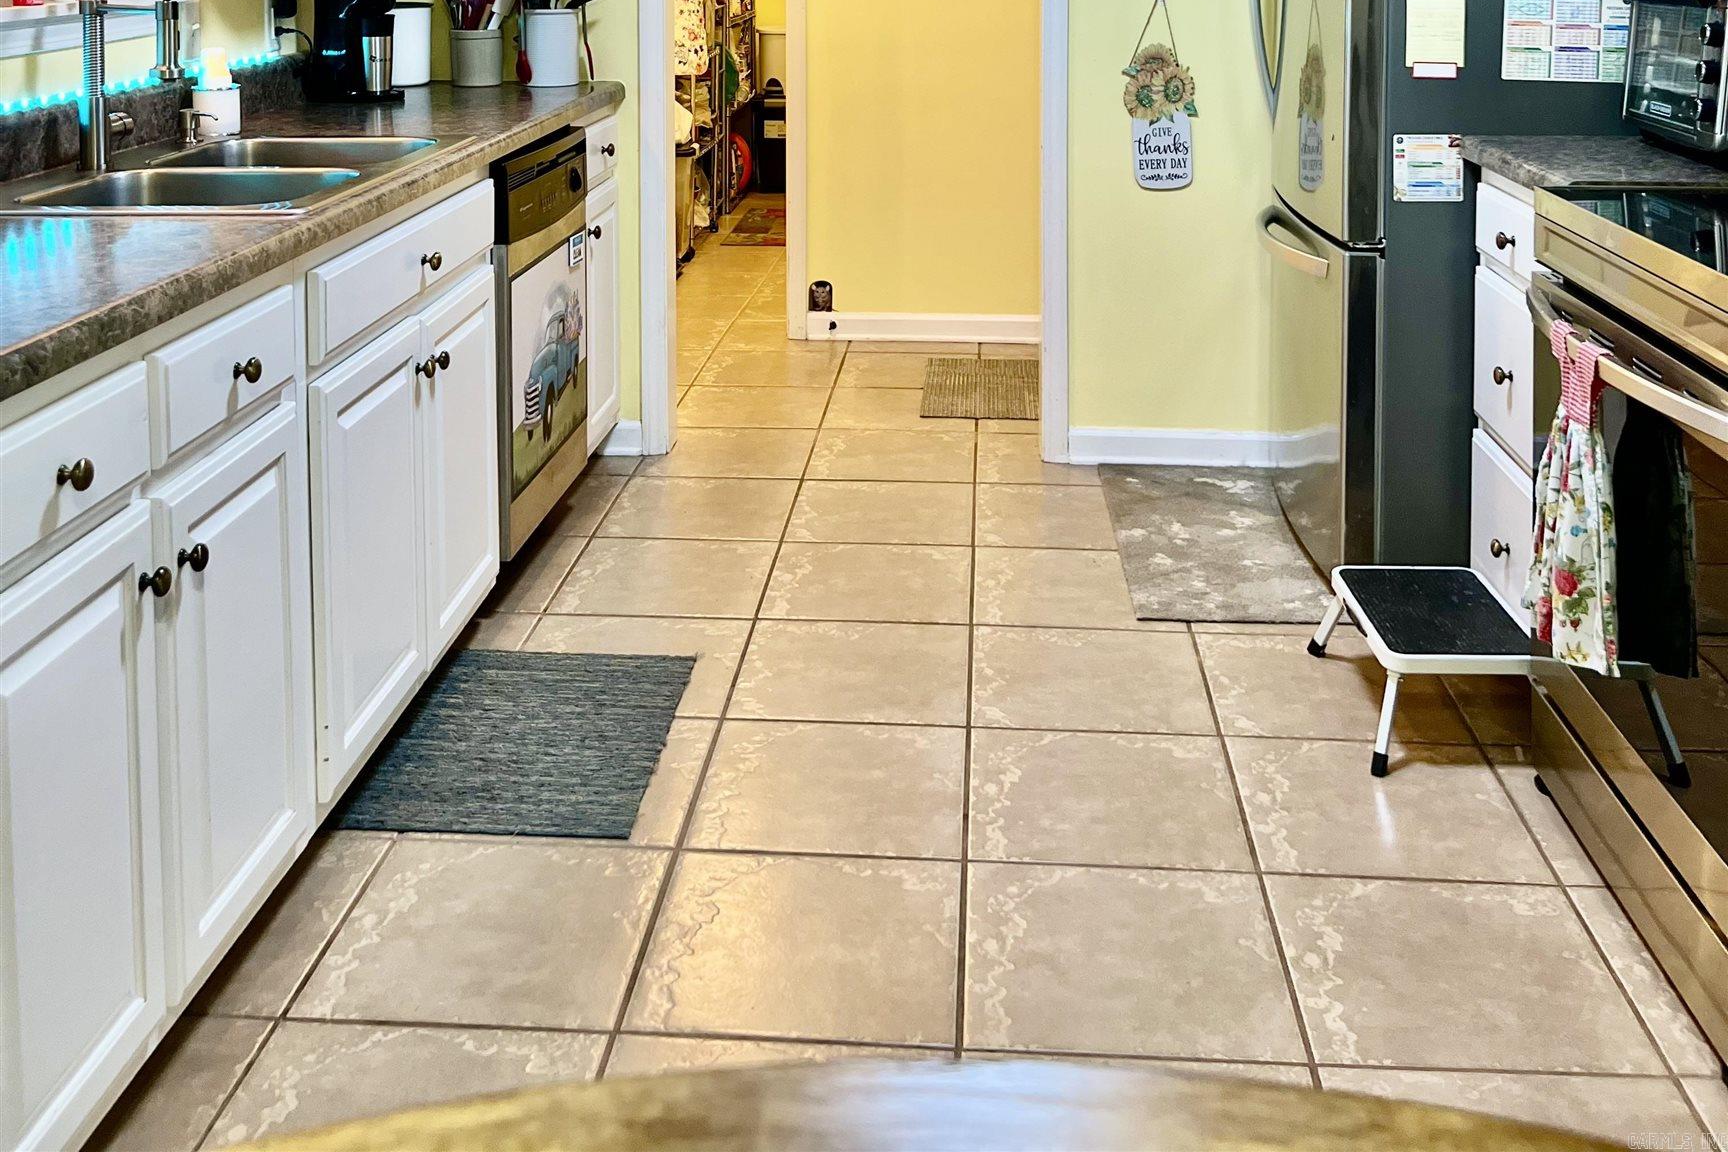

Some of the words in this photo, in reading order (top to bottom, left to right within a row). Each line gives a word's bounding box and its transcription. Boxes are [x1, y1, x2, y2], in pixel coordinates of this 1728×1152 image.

[1152, 127, 1172, 137] GIVE
[1134, 132, 1190, 155] thanks
[1139, 158, 1167, 170] EVERY
[1170, 157, 1188, 169] DAY
